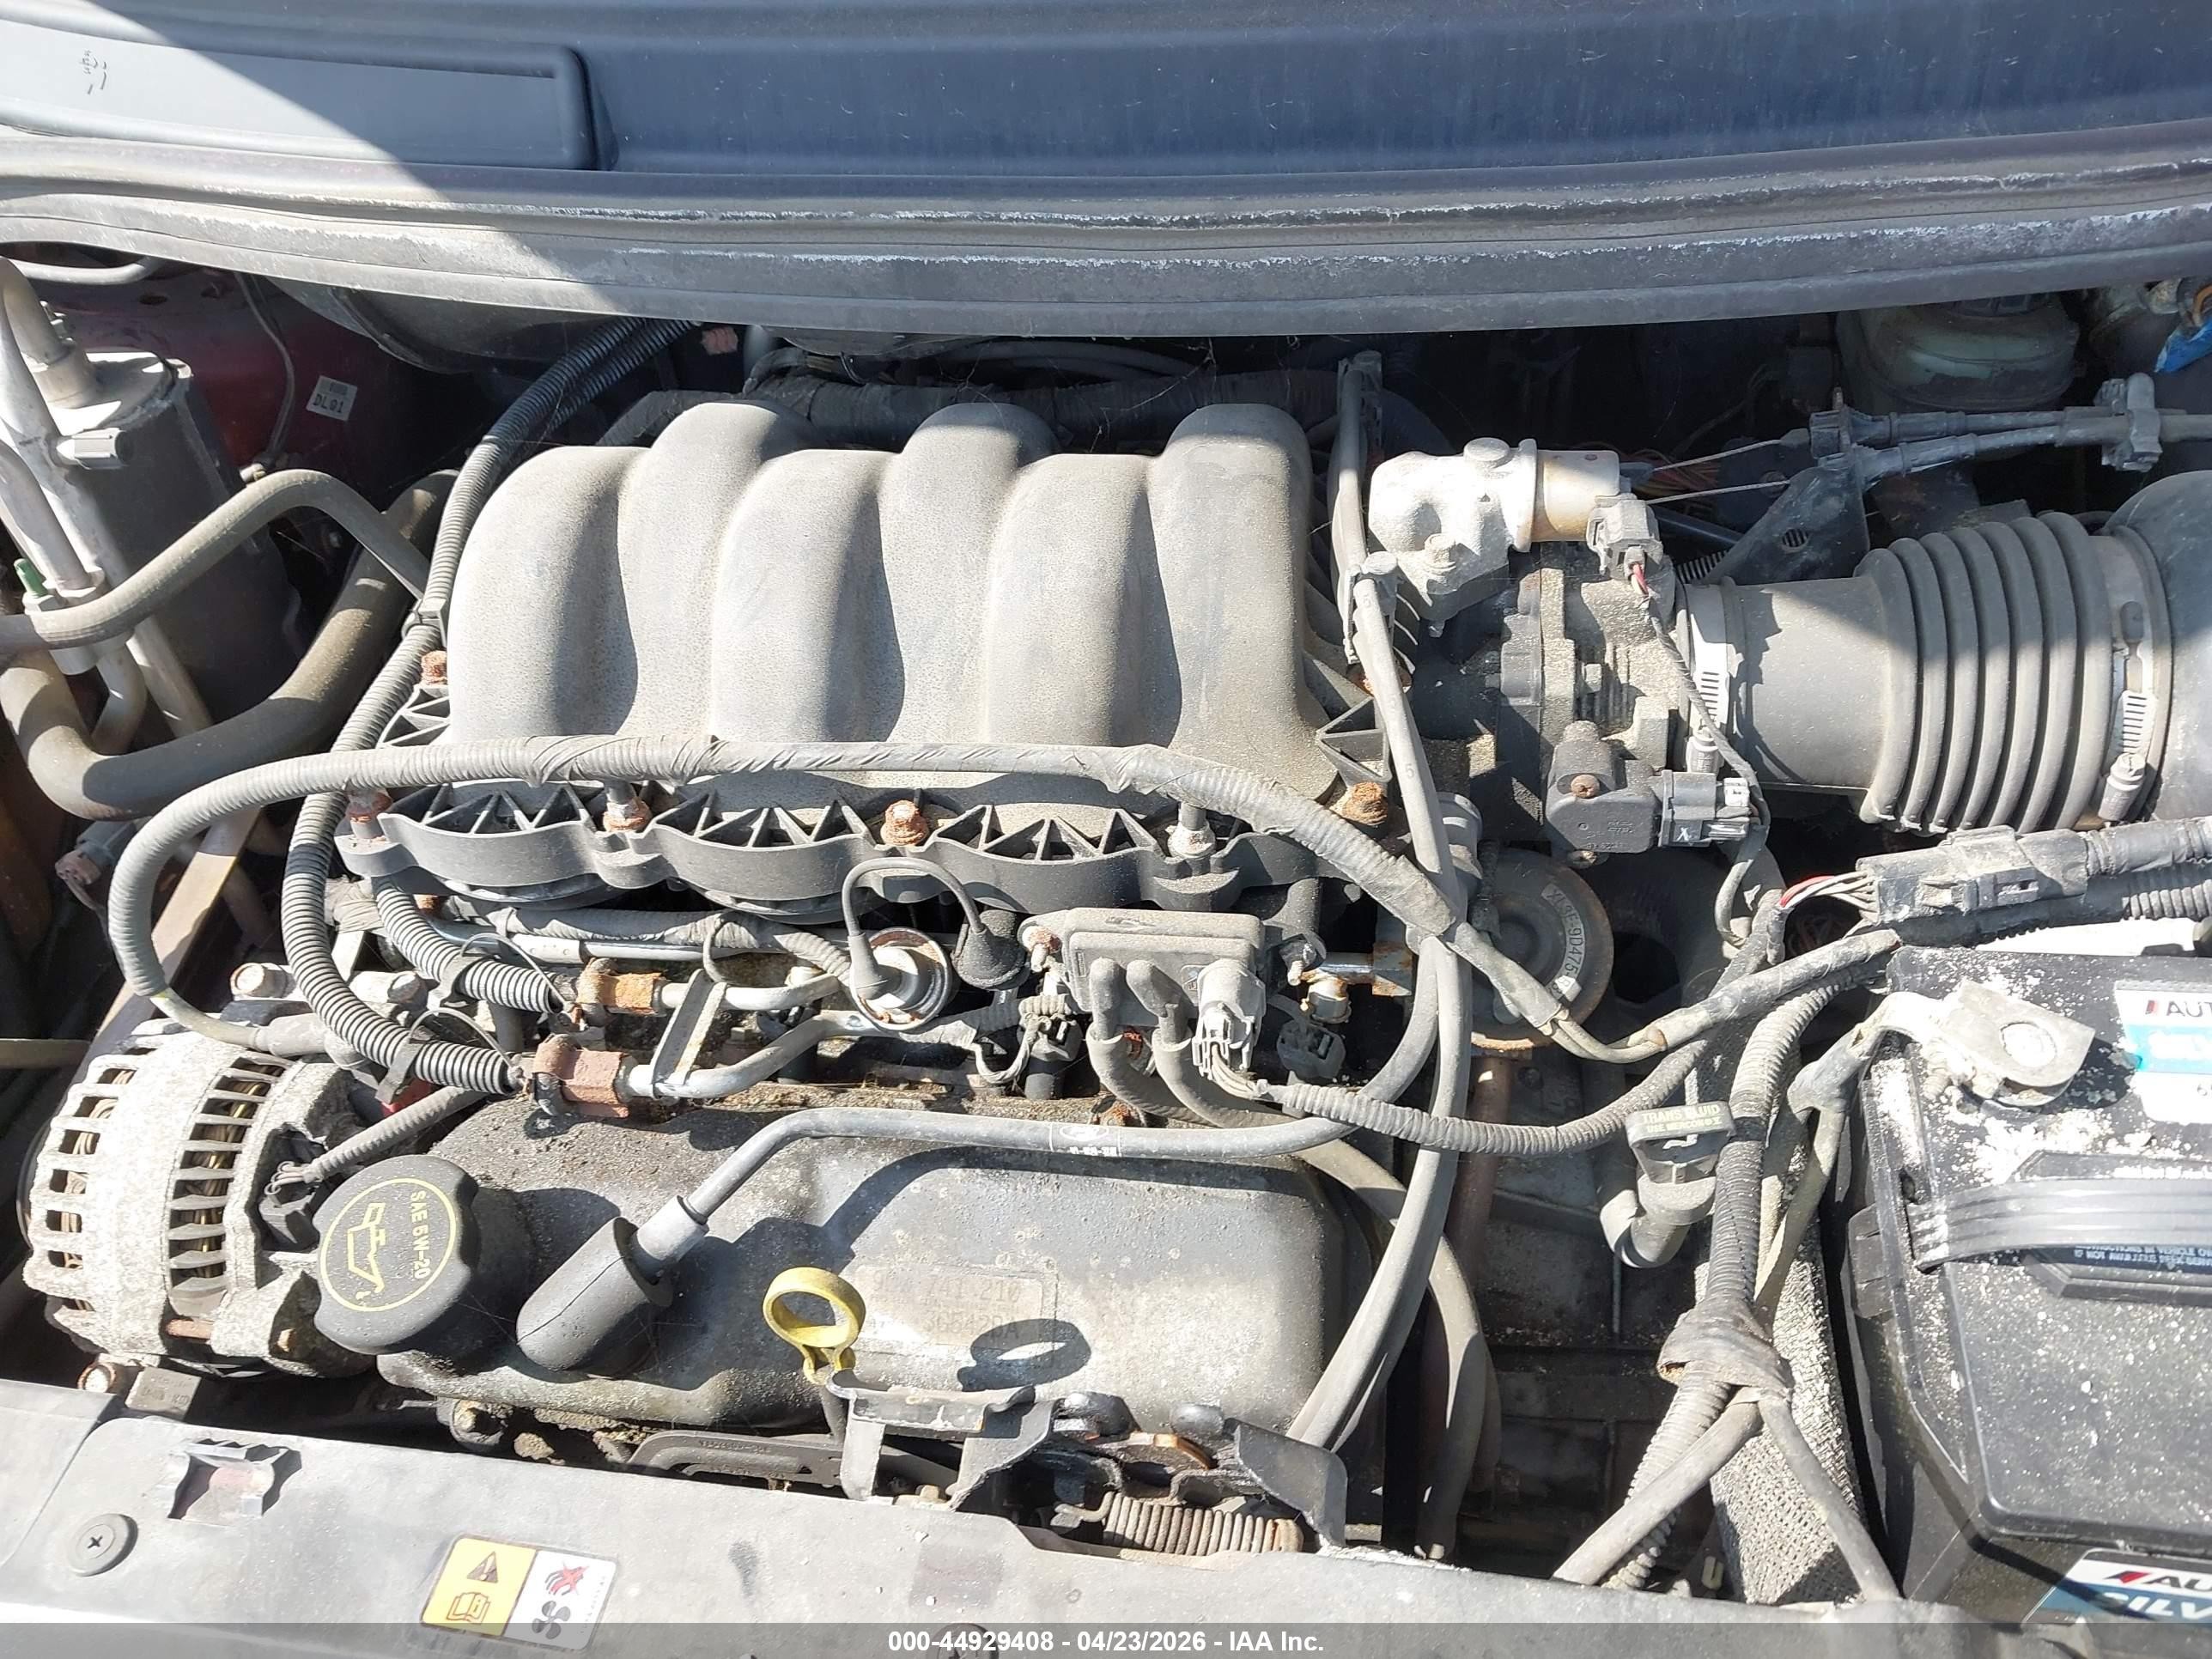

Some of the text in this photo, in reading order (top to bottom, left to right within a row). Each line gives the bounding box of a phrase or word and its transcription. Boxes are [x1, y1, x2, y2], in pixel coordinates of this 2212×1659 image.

[1642, 1104, 1721, 1124] TRANS FLUID
[1647, 1124, 1666, 1133] USE
[410, 1190, 430, 1279] SAE 5W-20
